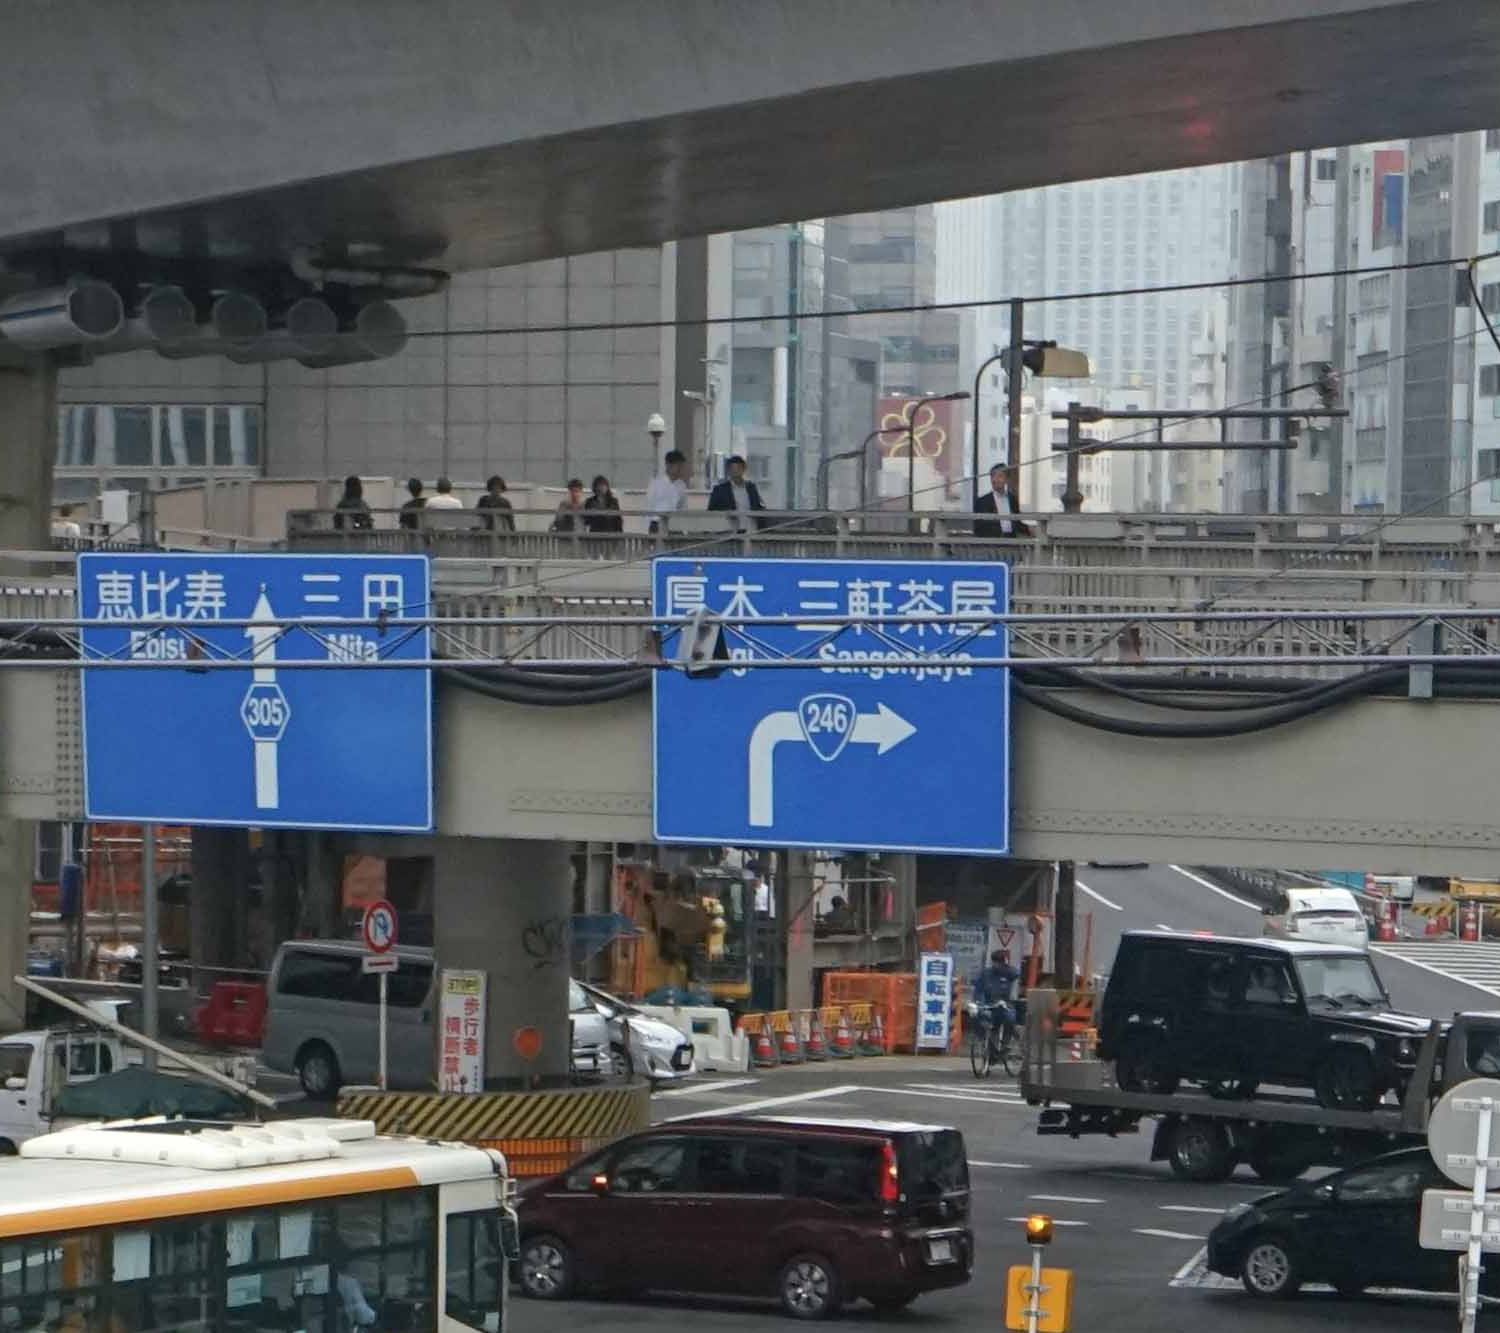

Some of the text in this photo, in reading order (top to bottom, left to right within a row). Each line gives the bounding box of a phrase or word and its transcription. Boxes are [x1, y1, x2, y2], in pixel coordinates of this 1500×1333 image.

[96, 570, 227, 621] 恵比寿
[666, 575, 764, 632] 厚木
[797, 578, 997, 636] 三軒茶屋
[247, 697, 284, 727] 305
[807, 702, 848, 734] 246
